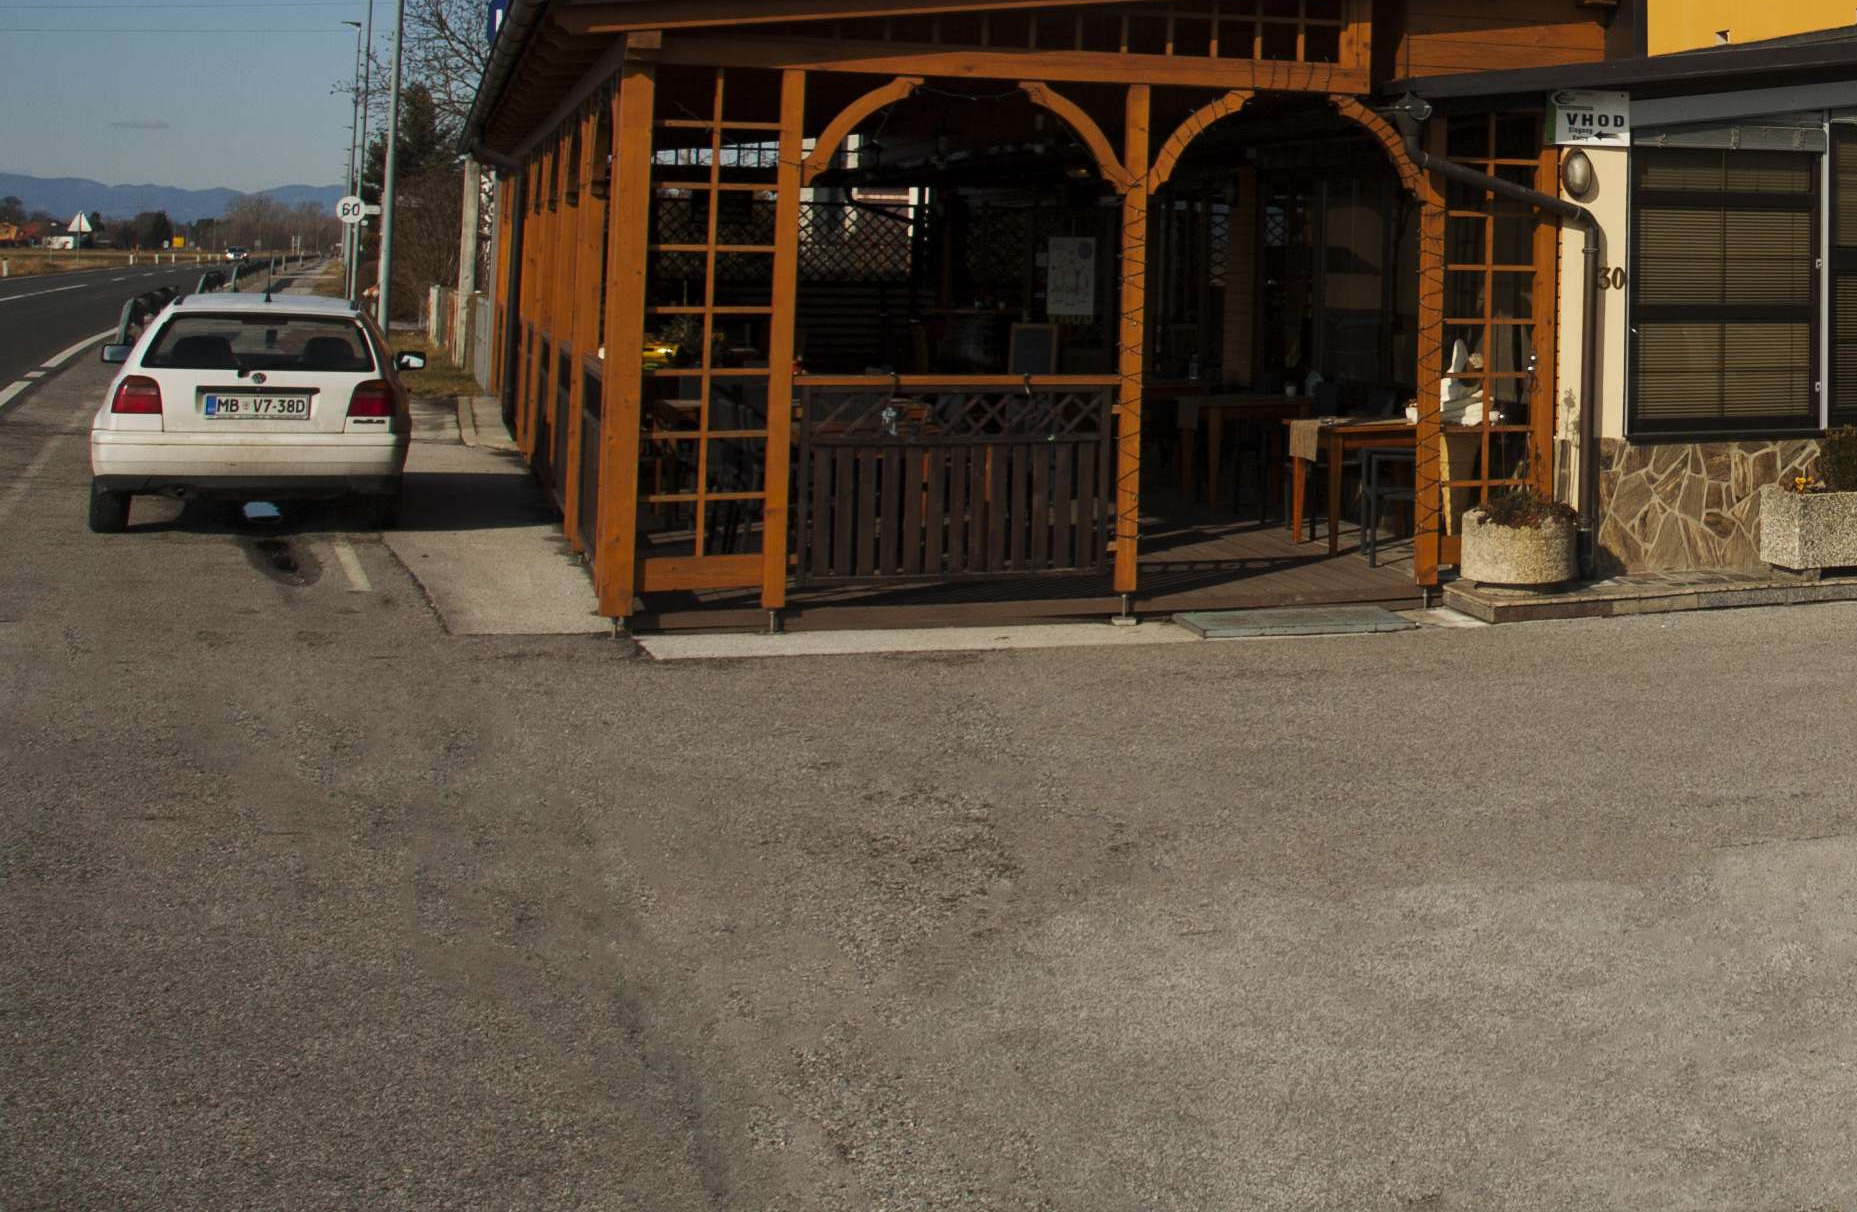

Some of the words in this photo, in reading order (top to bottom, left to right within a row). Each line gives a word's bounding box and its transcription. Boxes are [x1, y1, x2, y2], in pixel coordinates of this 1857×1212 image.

[1566, 113, 1625, 128] VHOD
[342, 202, 360, 216] 60
[1599, 266, 1626, 290] 30
[217, 399, 240, 413] MB
